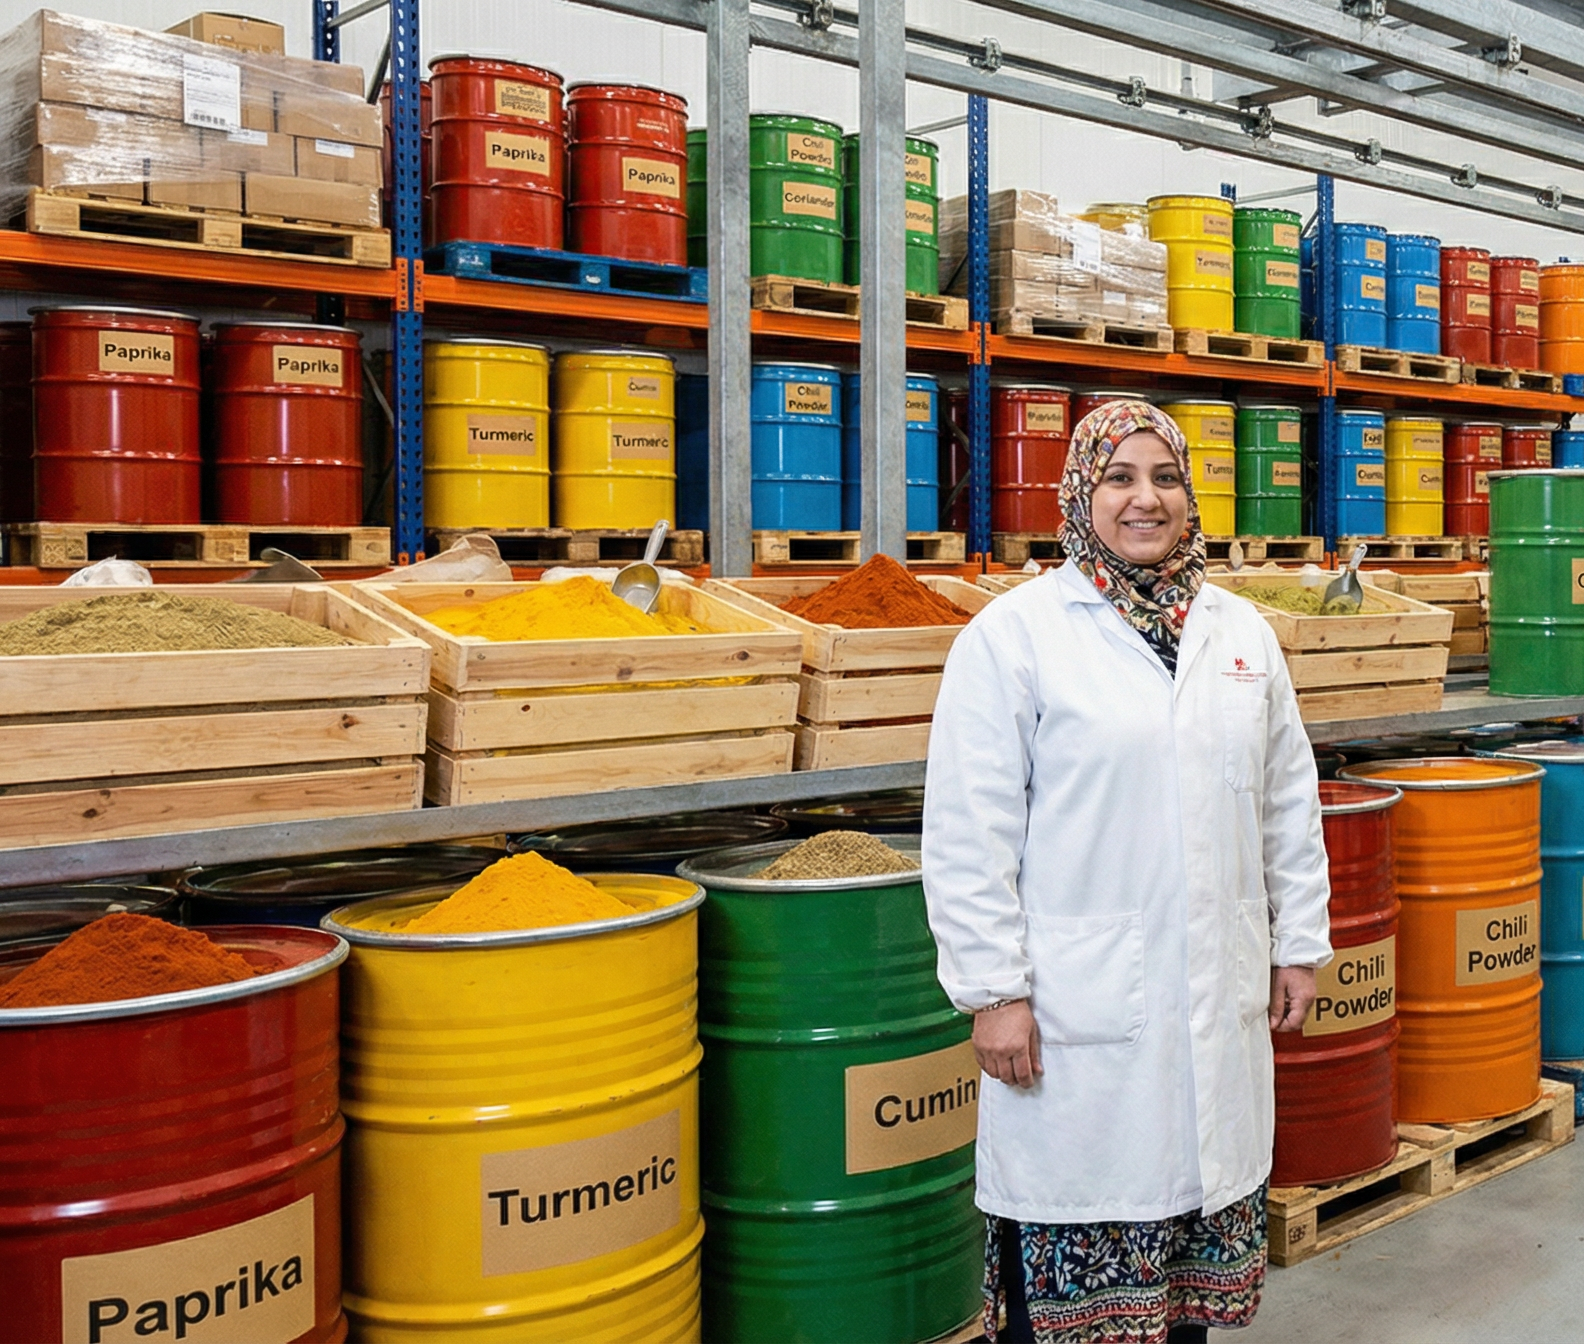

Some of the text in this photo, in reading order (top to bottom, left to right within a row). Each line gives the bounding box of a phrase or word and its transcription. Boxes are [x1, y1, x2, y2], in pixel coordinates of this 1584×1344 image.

[491, 143, 546, 163] Paprika
[103, 343, 172, 362] Paprika
[277, 357, 340, 375] Paprika
[468, 427, 535, 442] Turmeric
[612, 434, 669, 448] Turmeric
[1485, 914, 1528, 941] Chili
[1337, 953, 1385, 985] Chili
[1468, 943, 1537, 973] Powder
[1315, 986, 1394, 1021] Powder
[874, 1077, 977, 1128] Cumin
[487, 1155, 677, 1227] Turmeric
[87, 1254, 303, 1344] Paprika
